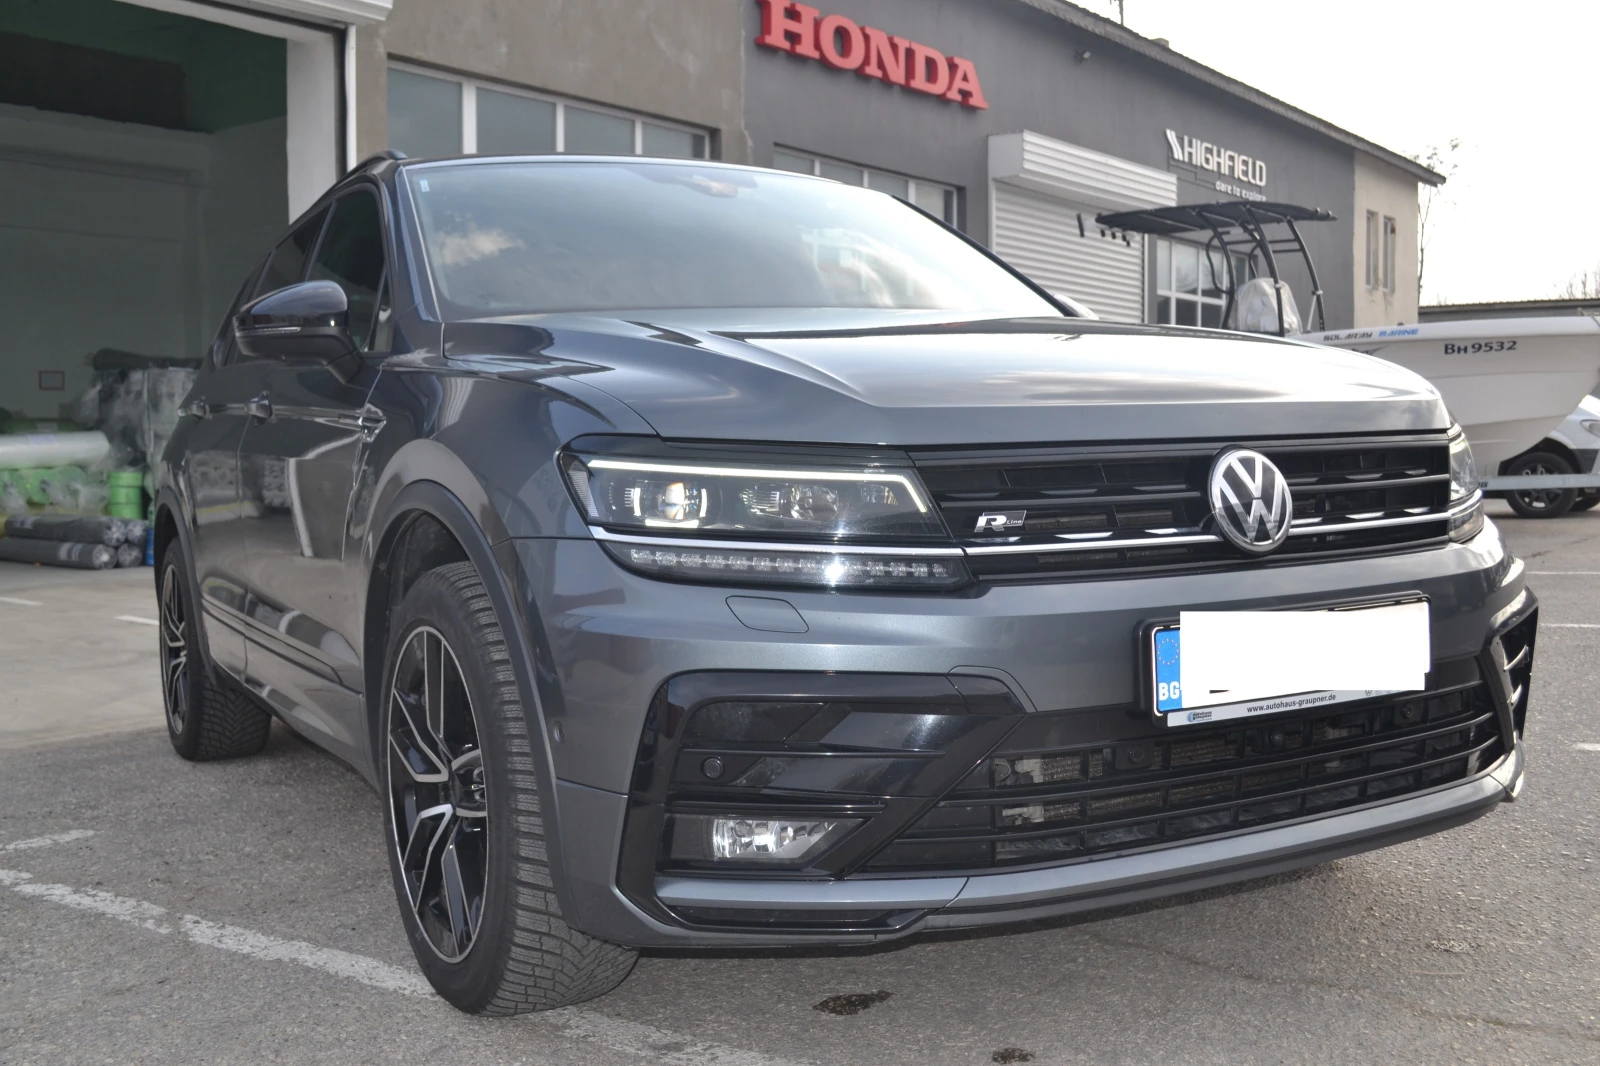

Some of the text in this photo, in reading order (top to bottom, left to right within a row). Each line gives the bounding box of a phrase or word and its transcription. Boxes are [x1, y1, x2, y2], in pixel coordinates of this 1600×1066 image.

[755, 0, 989, 110] HONDA
[1183, 135, 1266, 187] HIGHFIELD
[1215, 181, 1232, 194] dare
[1232, 184, 1240, 197] to
[1378, 328, 1419, 337] MARINE
[1471, 340, 1517, 354] 9532
[1158, 681, 1180, 700] BG
[1246, 693, 1337, 713] www.autohaus-graupner.de
